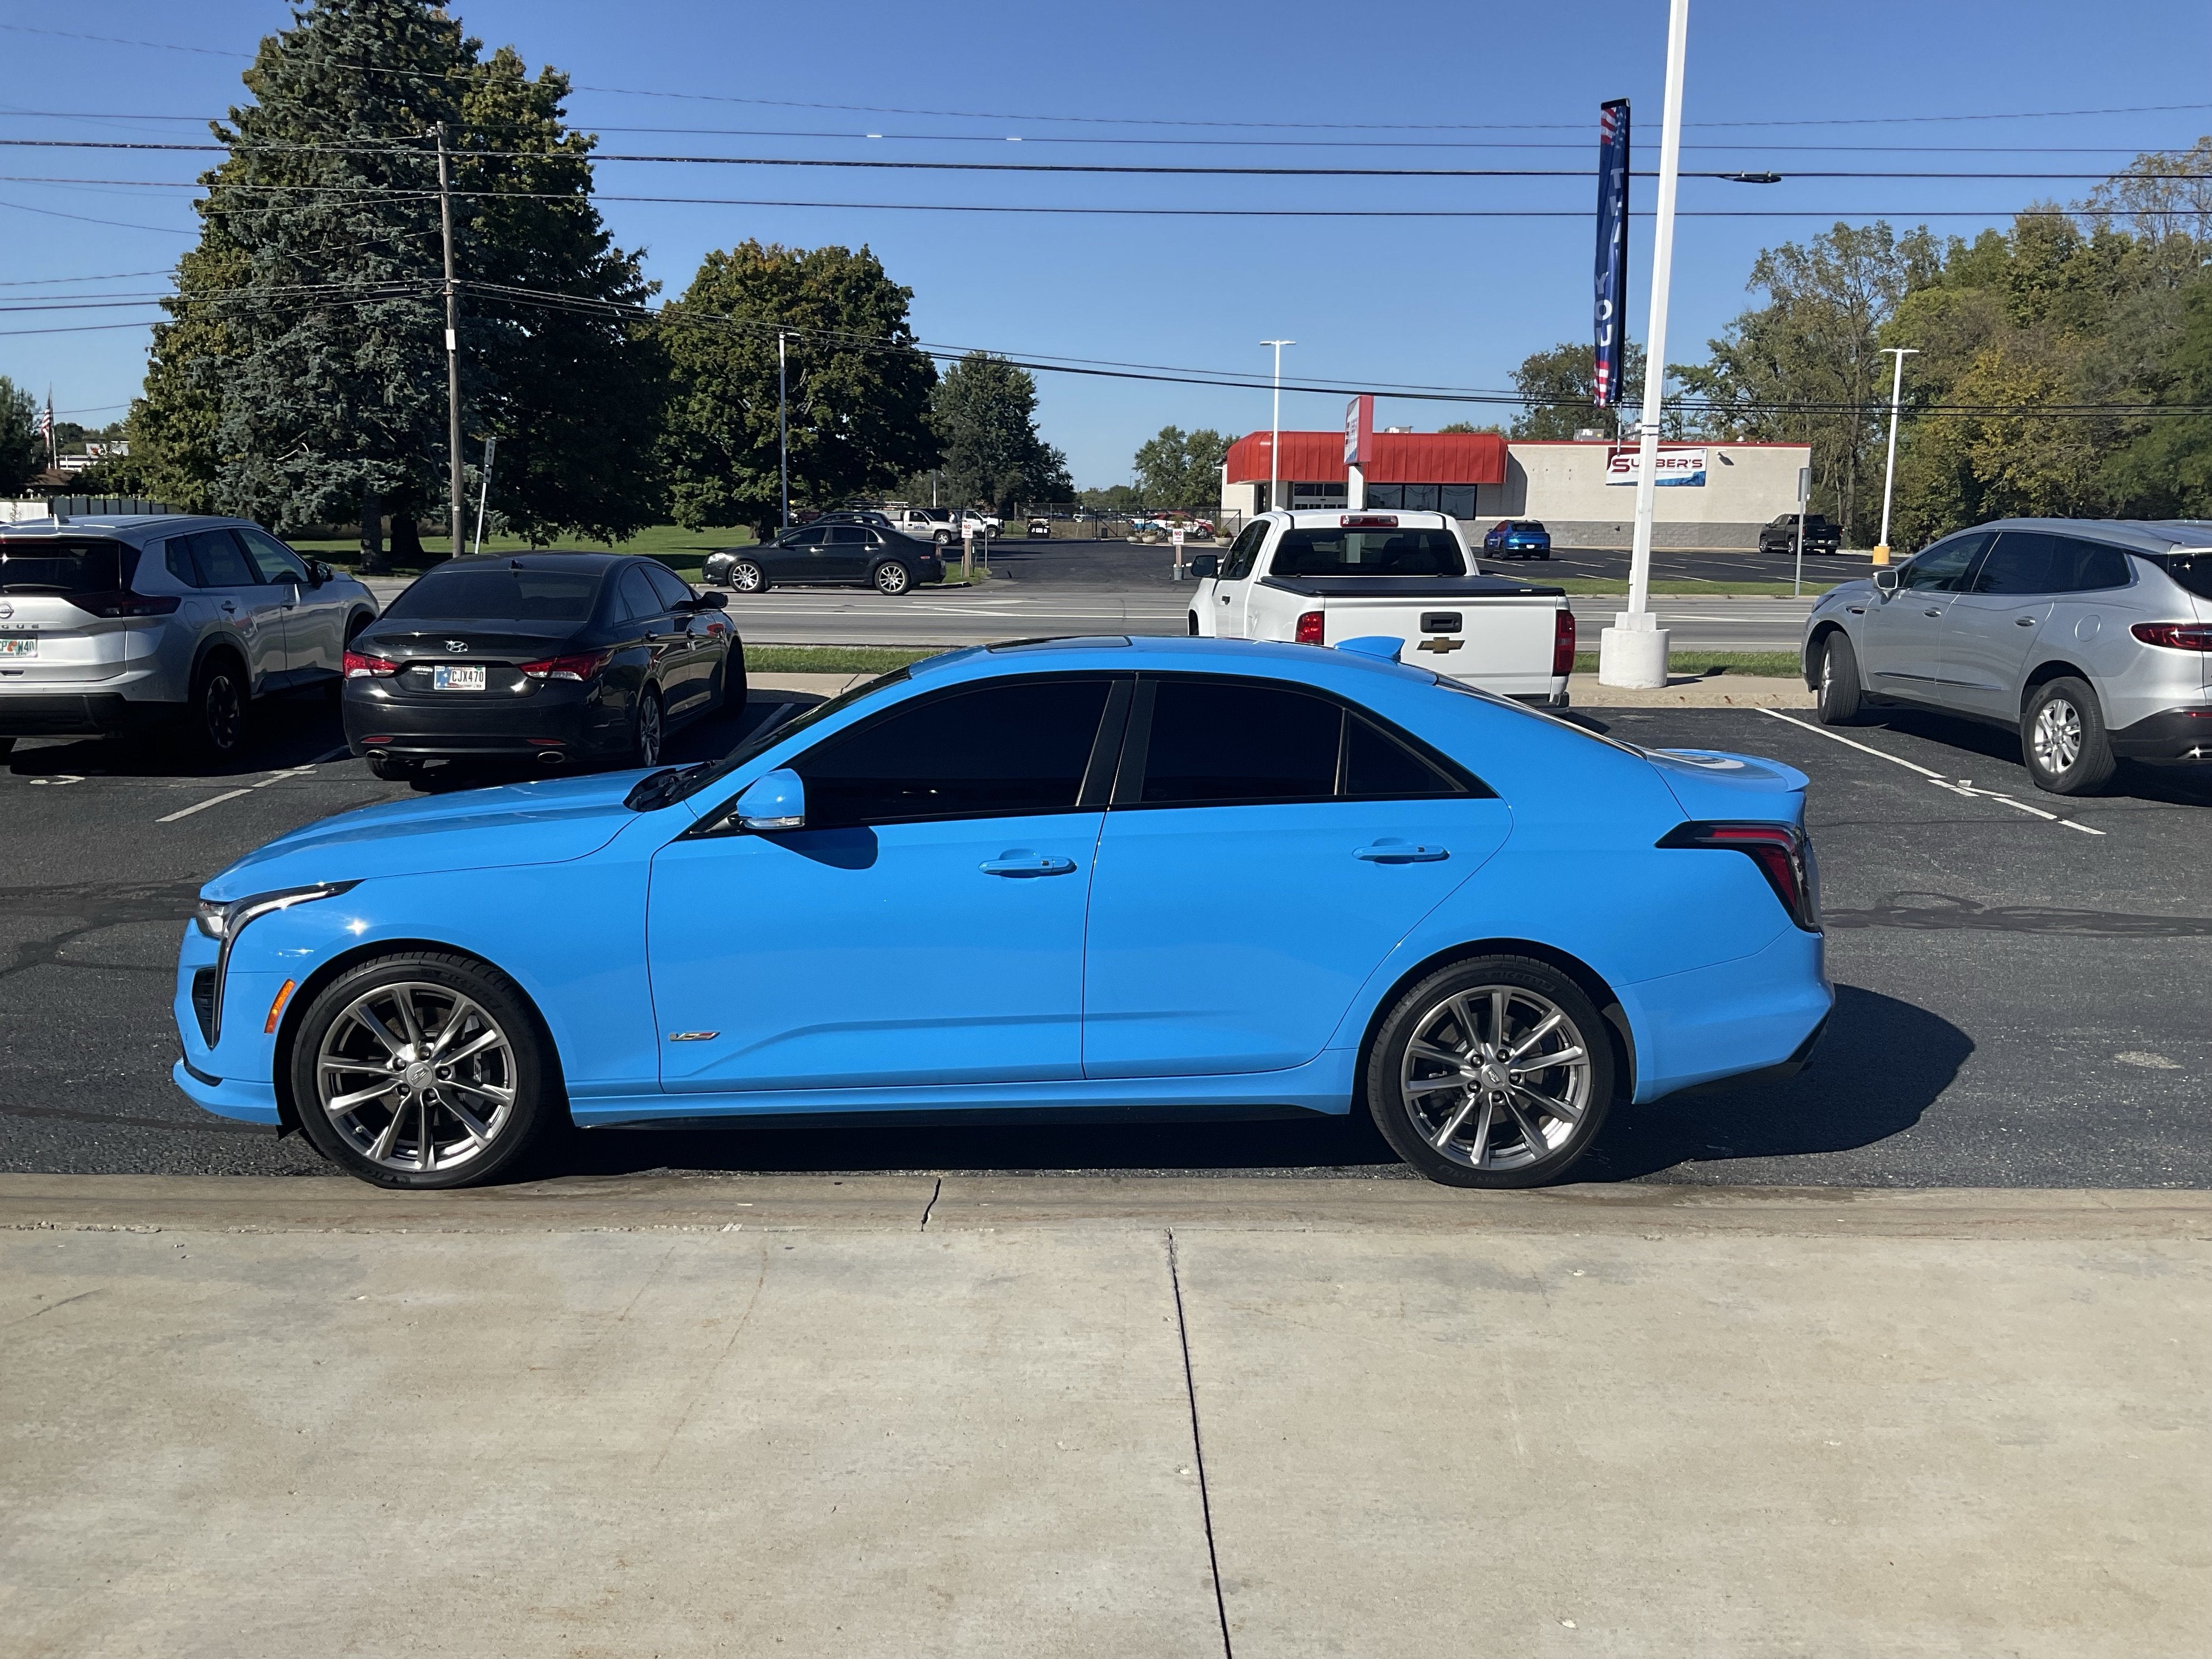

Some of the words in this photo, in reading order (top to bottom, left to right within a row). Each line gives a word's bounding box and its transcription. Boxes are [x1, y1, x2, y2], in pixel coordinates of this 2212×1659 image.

[1595, 272, 1612, 347] YOU
[1611, 459, 1703, 473] SUBER'S
[452, 671, 484, 682] CJX470
[1489, 972, 1554, 991] MICHELIN
